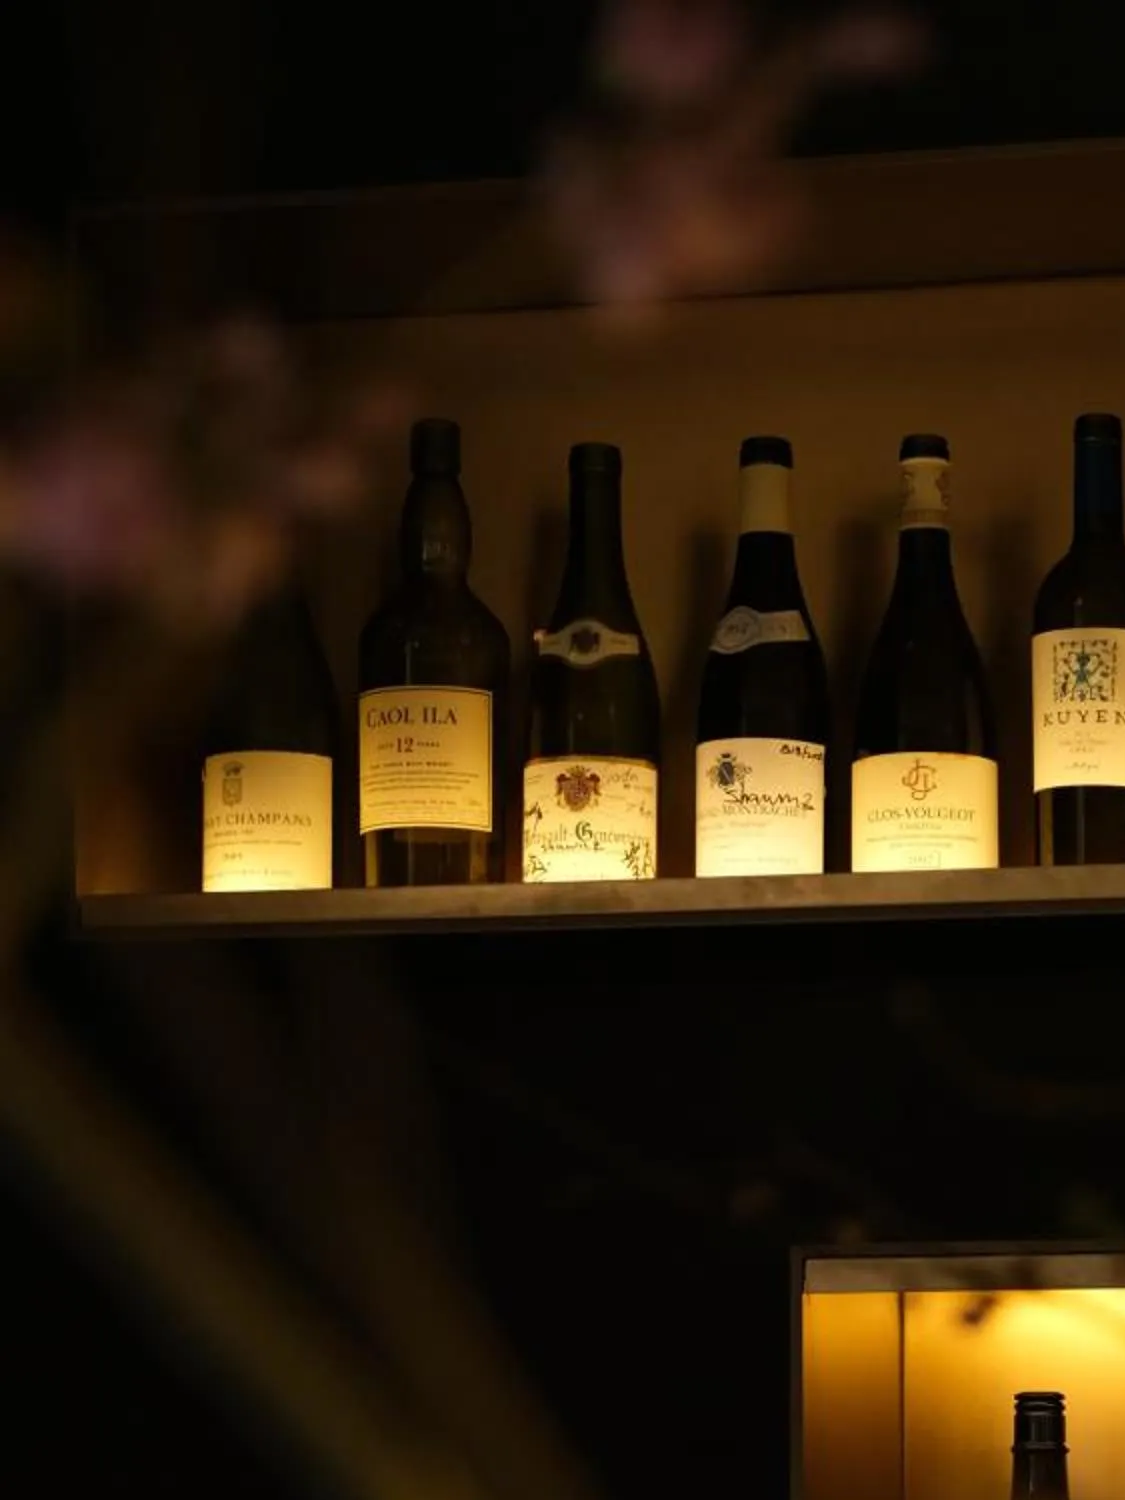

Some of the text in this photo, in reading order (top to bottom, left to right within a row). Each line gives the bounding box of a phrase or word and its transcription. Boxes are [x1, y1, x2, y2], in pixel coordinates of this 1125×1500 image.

[366, 705, 458, 729] CAOL ILA
[396, 737, 414, 753] 12
